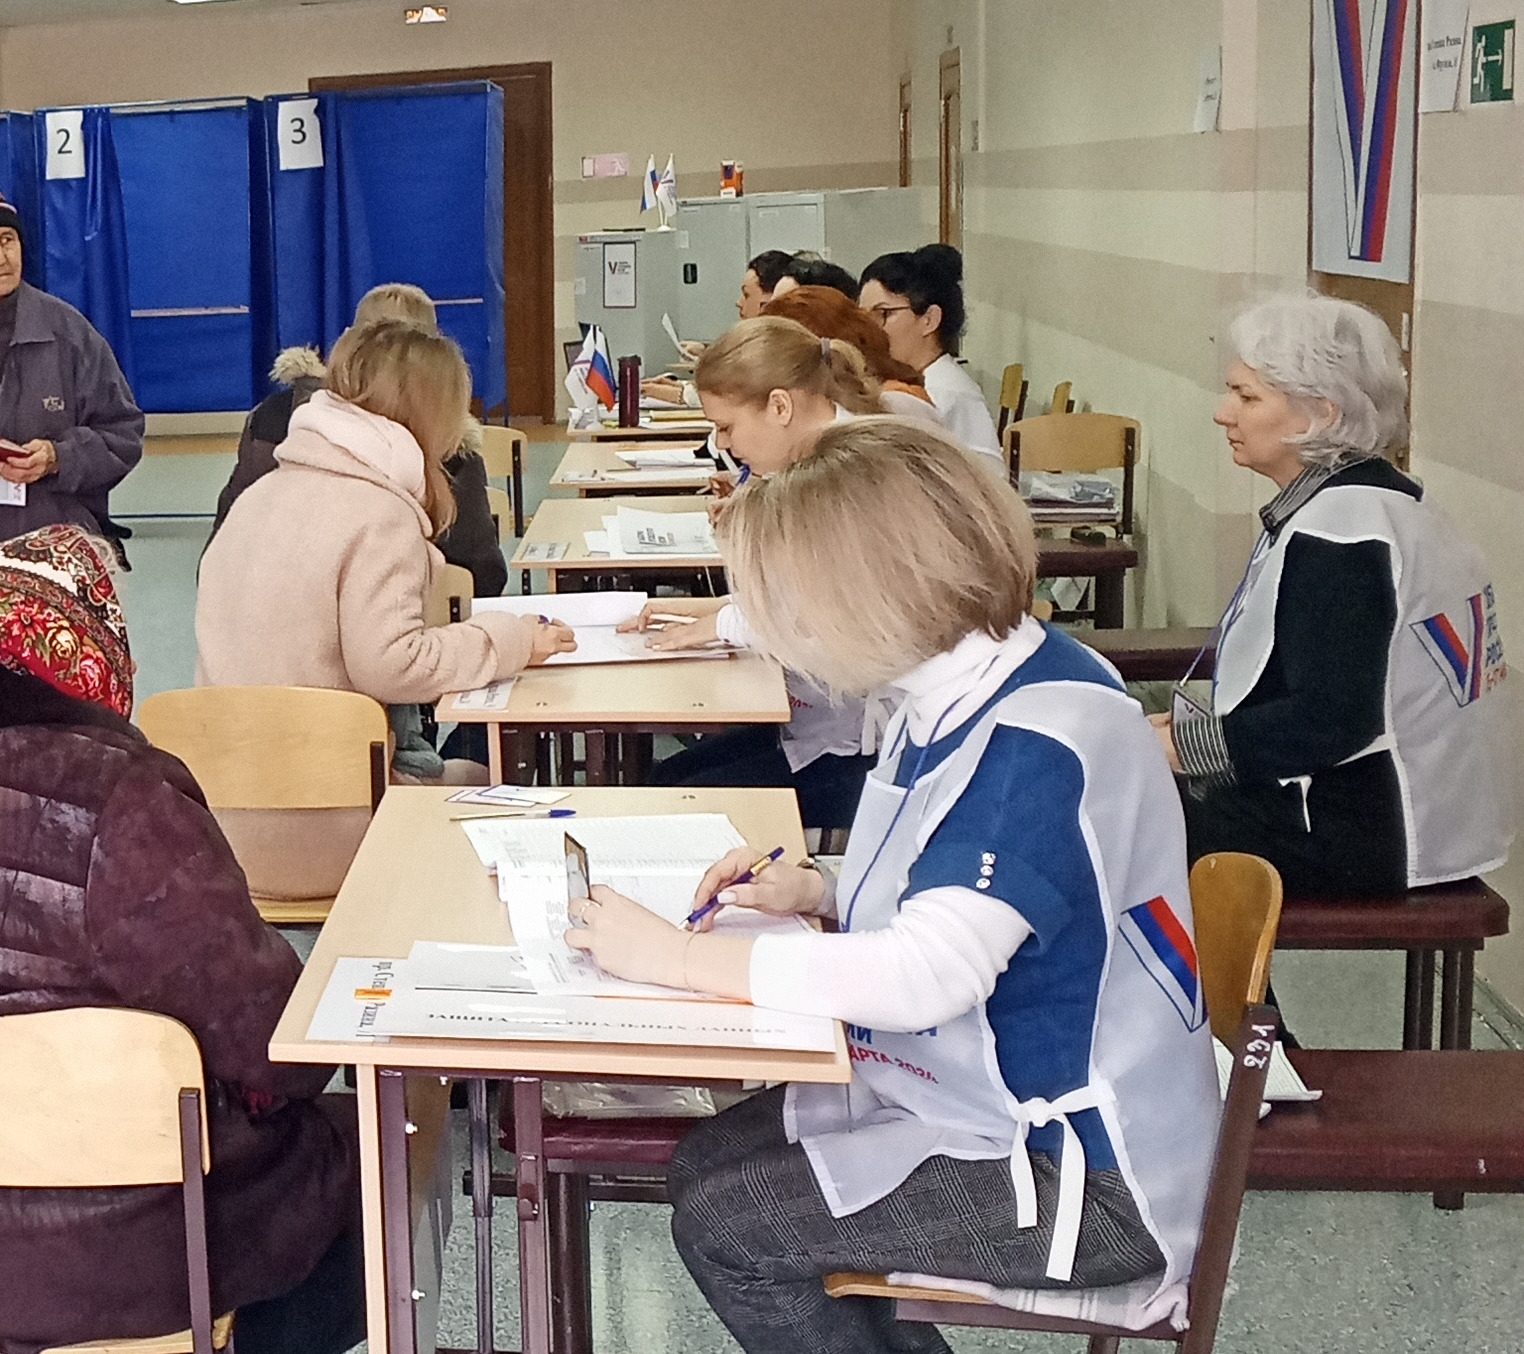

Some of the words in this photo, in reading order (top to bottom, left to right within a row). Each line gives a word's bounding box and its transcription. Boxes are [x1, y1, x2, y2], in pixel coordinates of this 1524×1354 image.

[56, 128, 72, 155] 2
[290, 118, 307, 144] 3
[847, 1043, 894, 1065] АРТА
